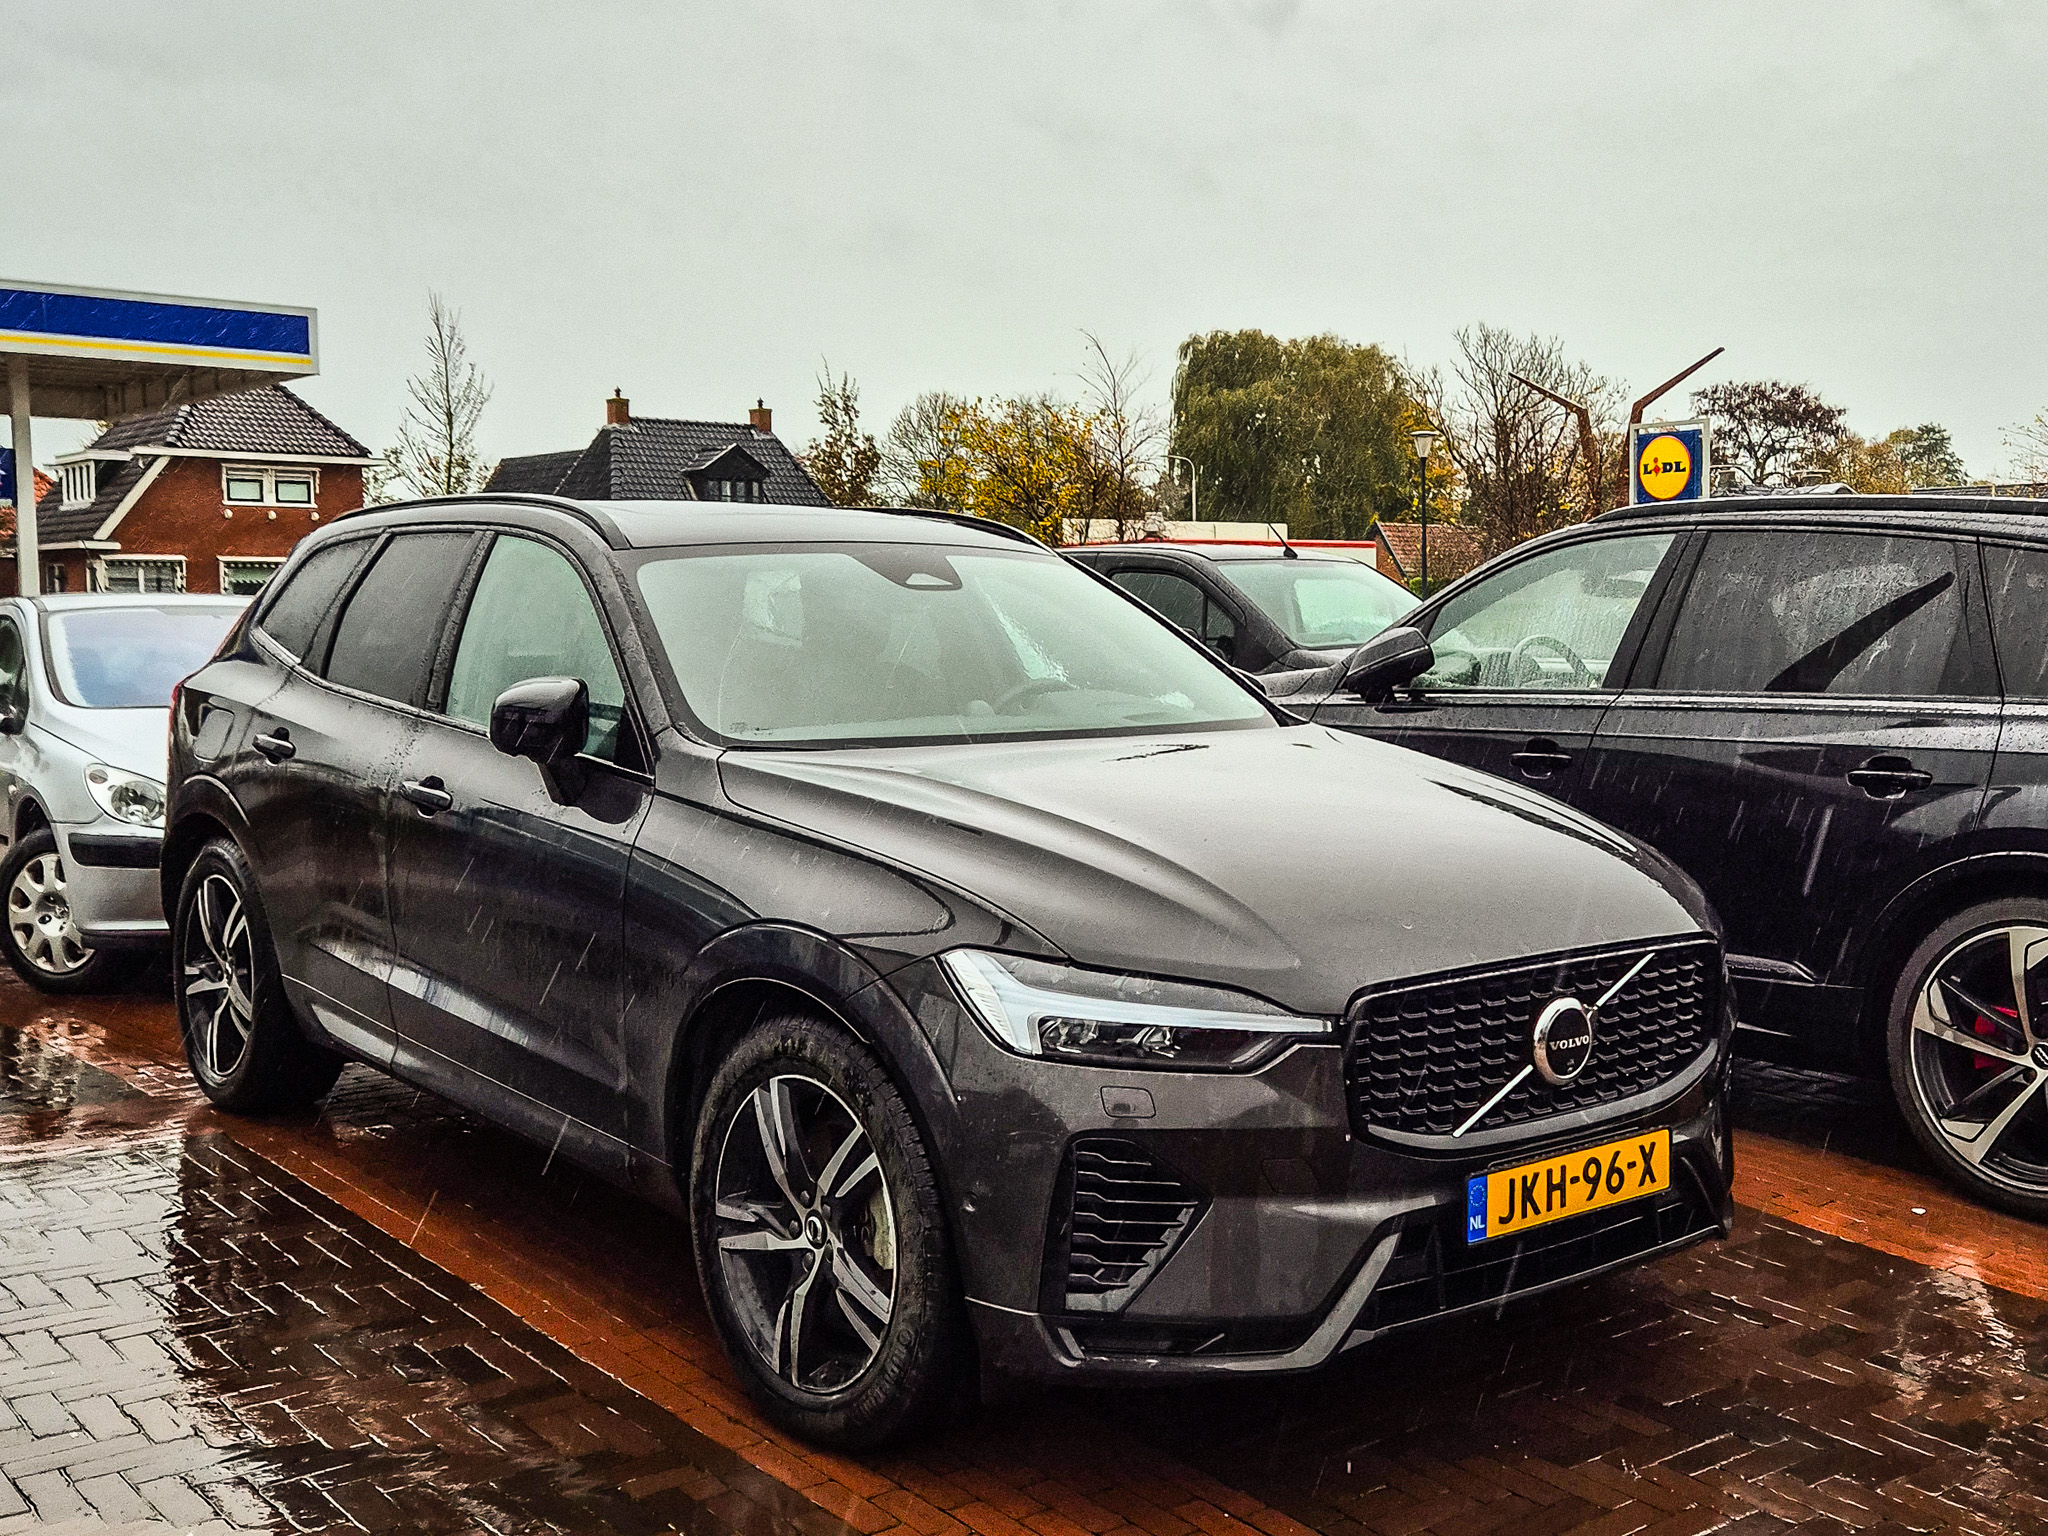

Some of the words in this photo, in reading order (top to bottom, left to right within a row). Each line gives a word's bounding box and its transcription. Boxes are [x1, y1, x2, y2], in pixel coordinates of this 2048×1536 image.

[1549, 1035, 1590, 1051] VOLVO
[1498, 1141, 1657, 1225] JKH-96-X
[1469, 1215, 1485, 1231] NL
